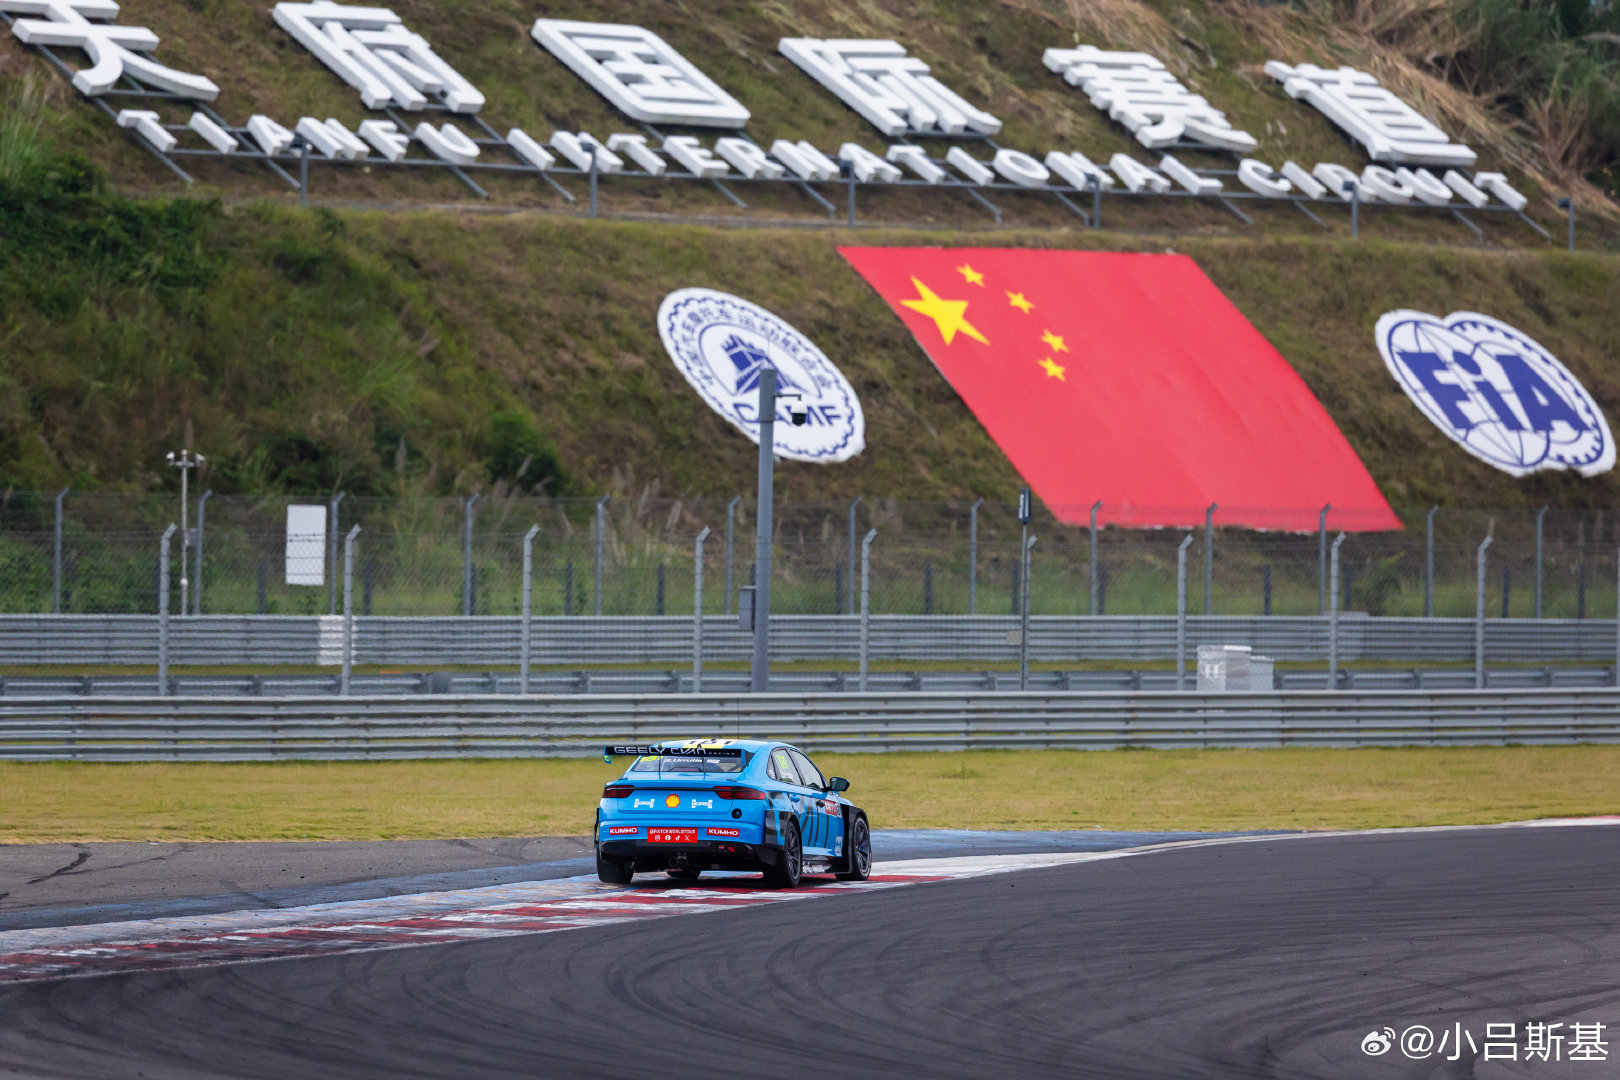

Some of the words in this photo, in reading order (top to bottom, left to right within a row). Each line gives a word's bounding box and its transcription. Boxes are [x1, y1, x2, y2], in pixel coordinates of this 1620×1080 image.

[0, 0, 1477, 166] 天府国际赛道
[117, 109, 480, 164] TIANFU
[506, 128, 1223, 196] INTERNATIONAL
[1238, 158, 1528, 210] CIRCUIT
[613, 746, 666, 754] GEELY
[708, 828, 739, 836] KUMHO
